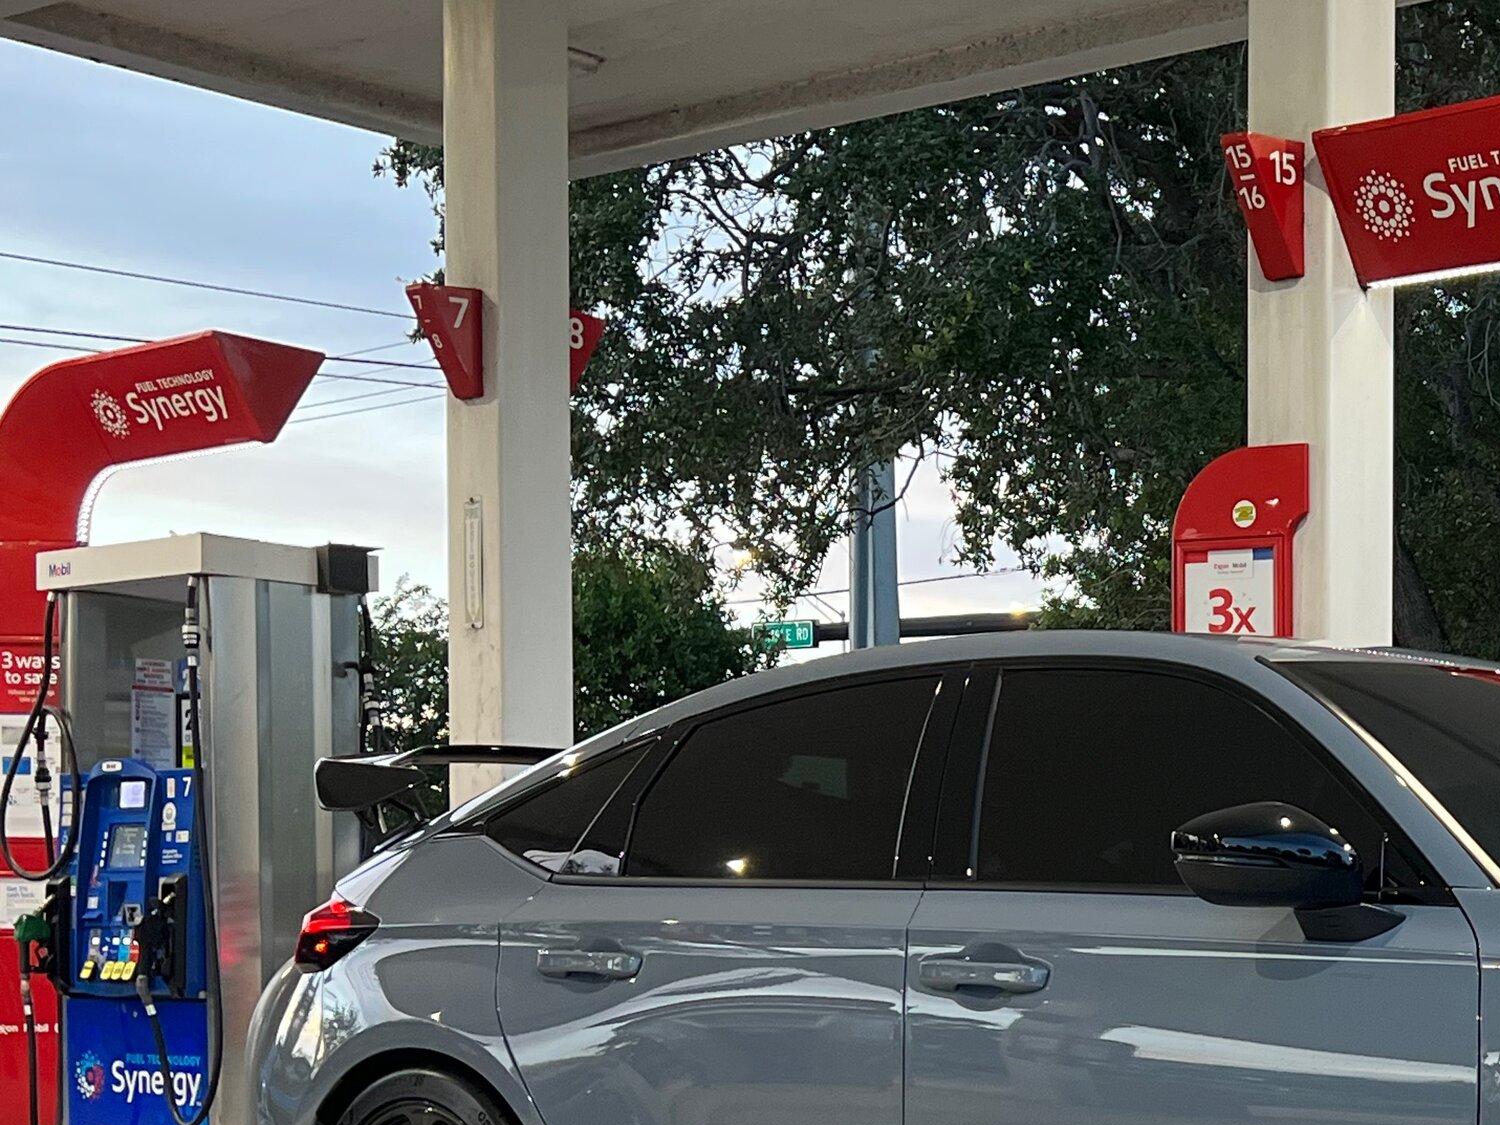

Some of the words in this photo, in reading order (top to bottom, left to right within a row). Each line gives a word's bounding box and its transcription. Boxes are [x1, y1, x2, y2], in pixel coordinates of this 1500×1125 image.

[1225, 144, 1251, 169] 15
[1269, 150, 1297, 186] 15
[1448, 151, 1487, 172] FUEL
[1239, 185, 1266, 210] 16
[448, 296, 469, 329] 7
[431, 333, 443, 349] 8
[569, 317, 584, 350] 8
[135, 381, 155, 394] FUEL
[158, 369, 214, 388] TECHNOLOGY
[125, 385, 229, 431] Synergy
[49, 562, 71, 577] Mobil
[1208, 588, 1256, 634] 3x
[796, 627, 809, 641] RD
[1, 651, 13, 669] 3
[5, 670, 21, 684] to
[182, 776, 191, 798] 7
[147, 1054, 201, 1066] TECNOLOGY
